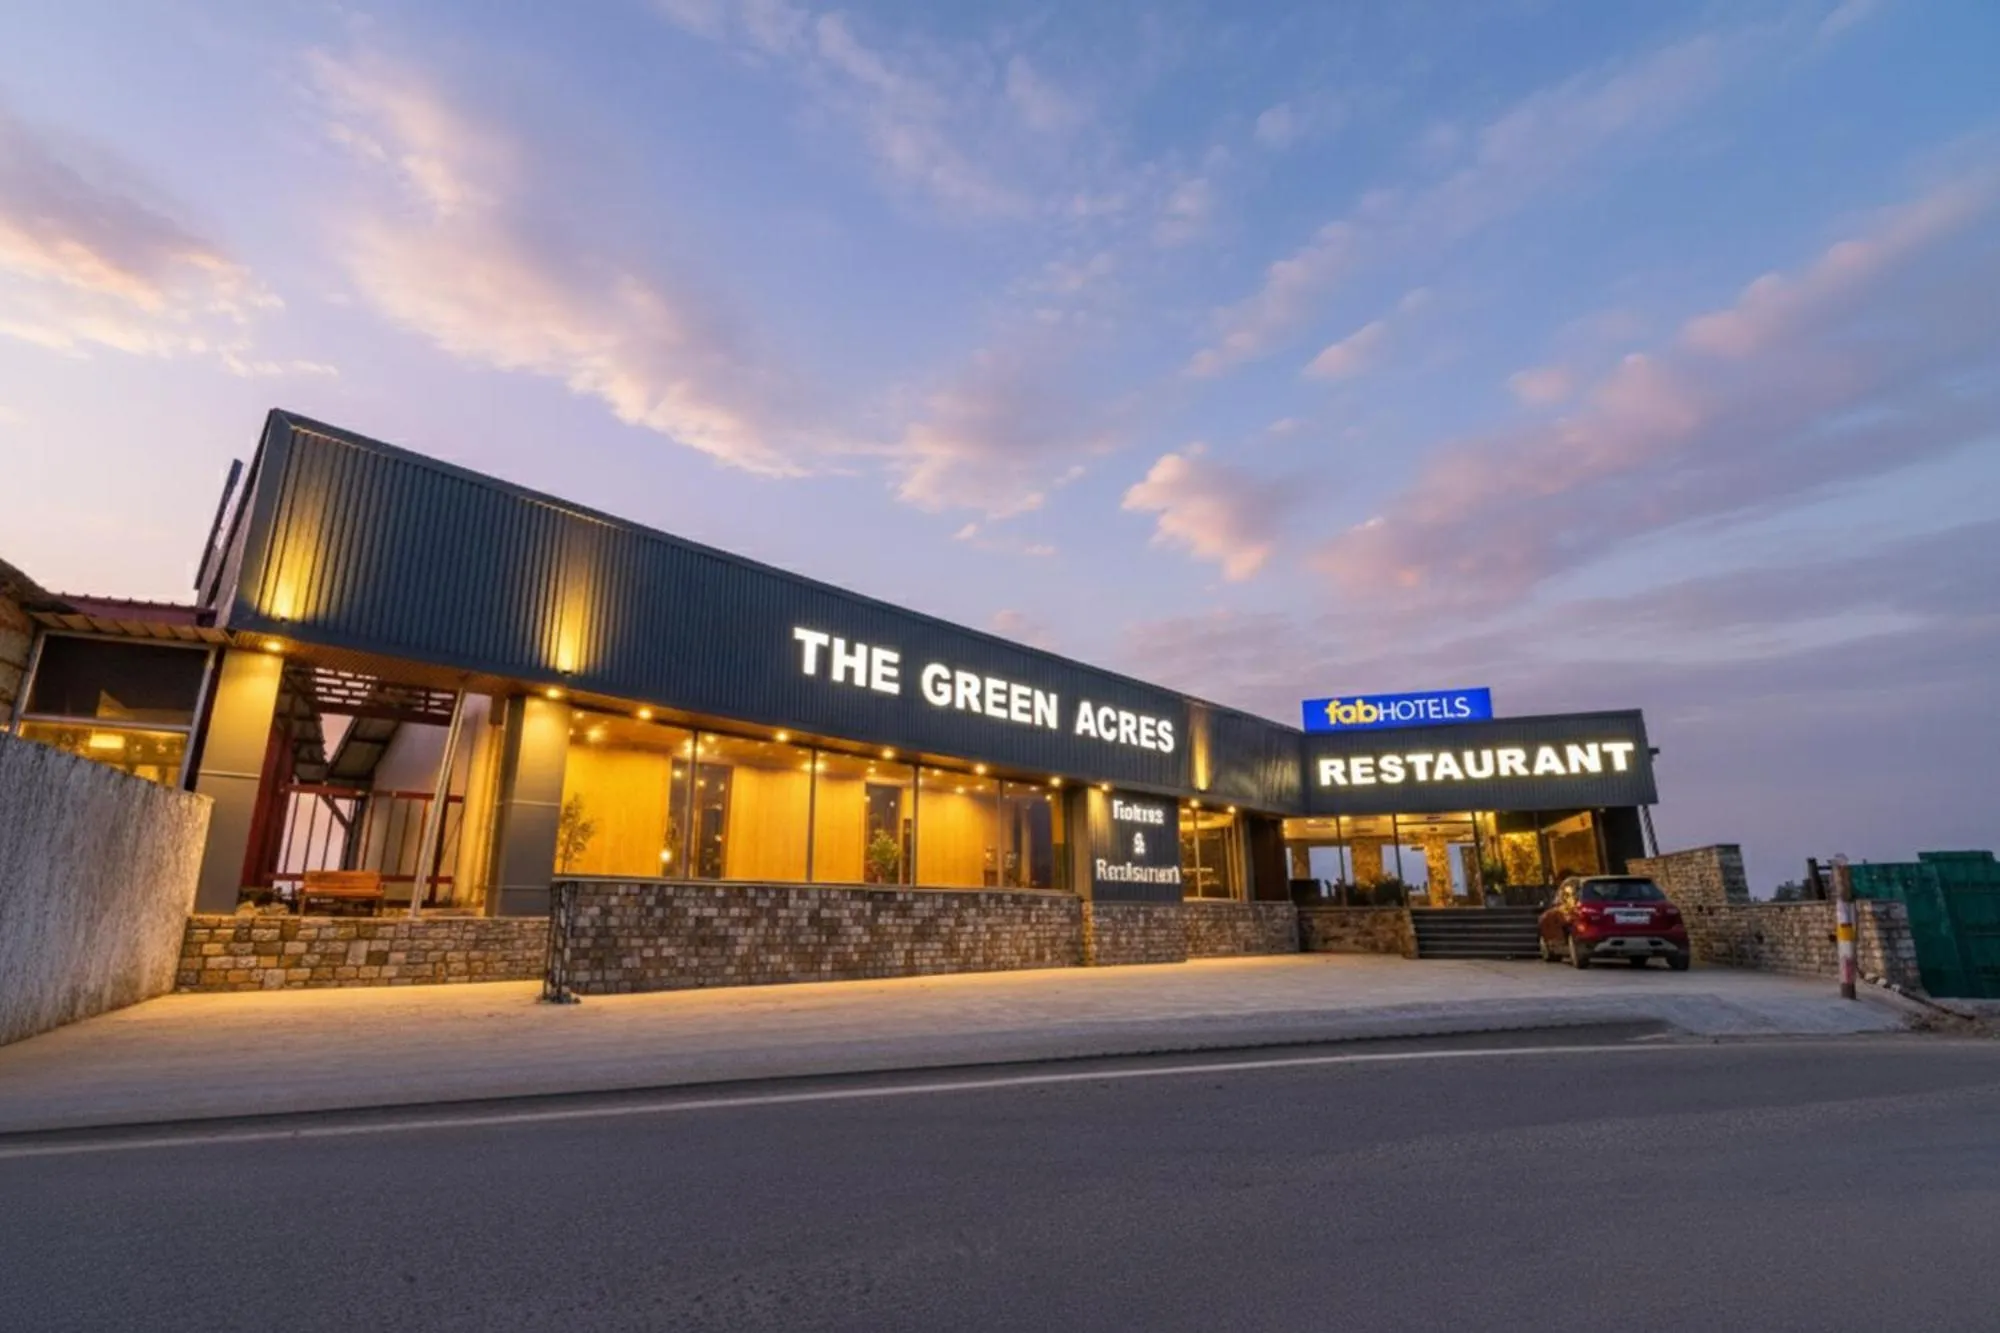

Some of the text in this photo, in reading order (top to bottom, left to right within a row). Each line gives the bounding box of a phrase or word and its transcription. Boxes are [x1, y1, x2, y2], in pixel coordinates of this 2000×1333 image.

[793, 626, 1175, 754] THE GREEN ACRES
[1325, 697, 1471, 725] fabHOTELS
[1318, 741, 1634, 787] RESTAURANT
